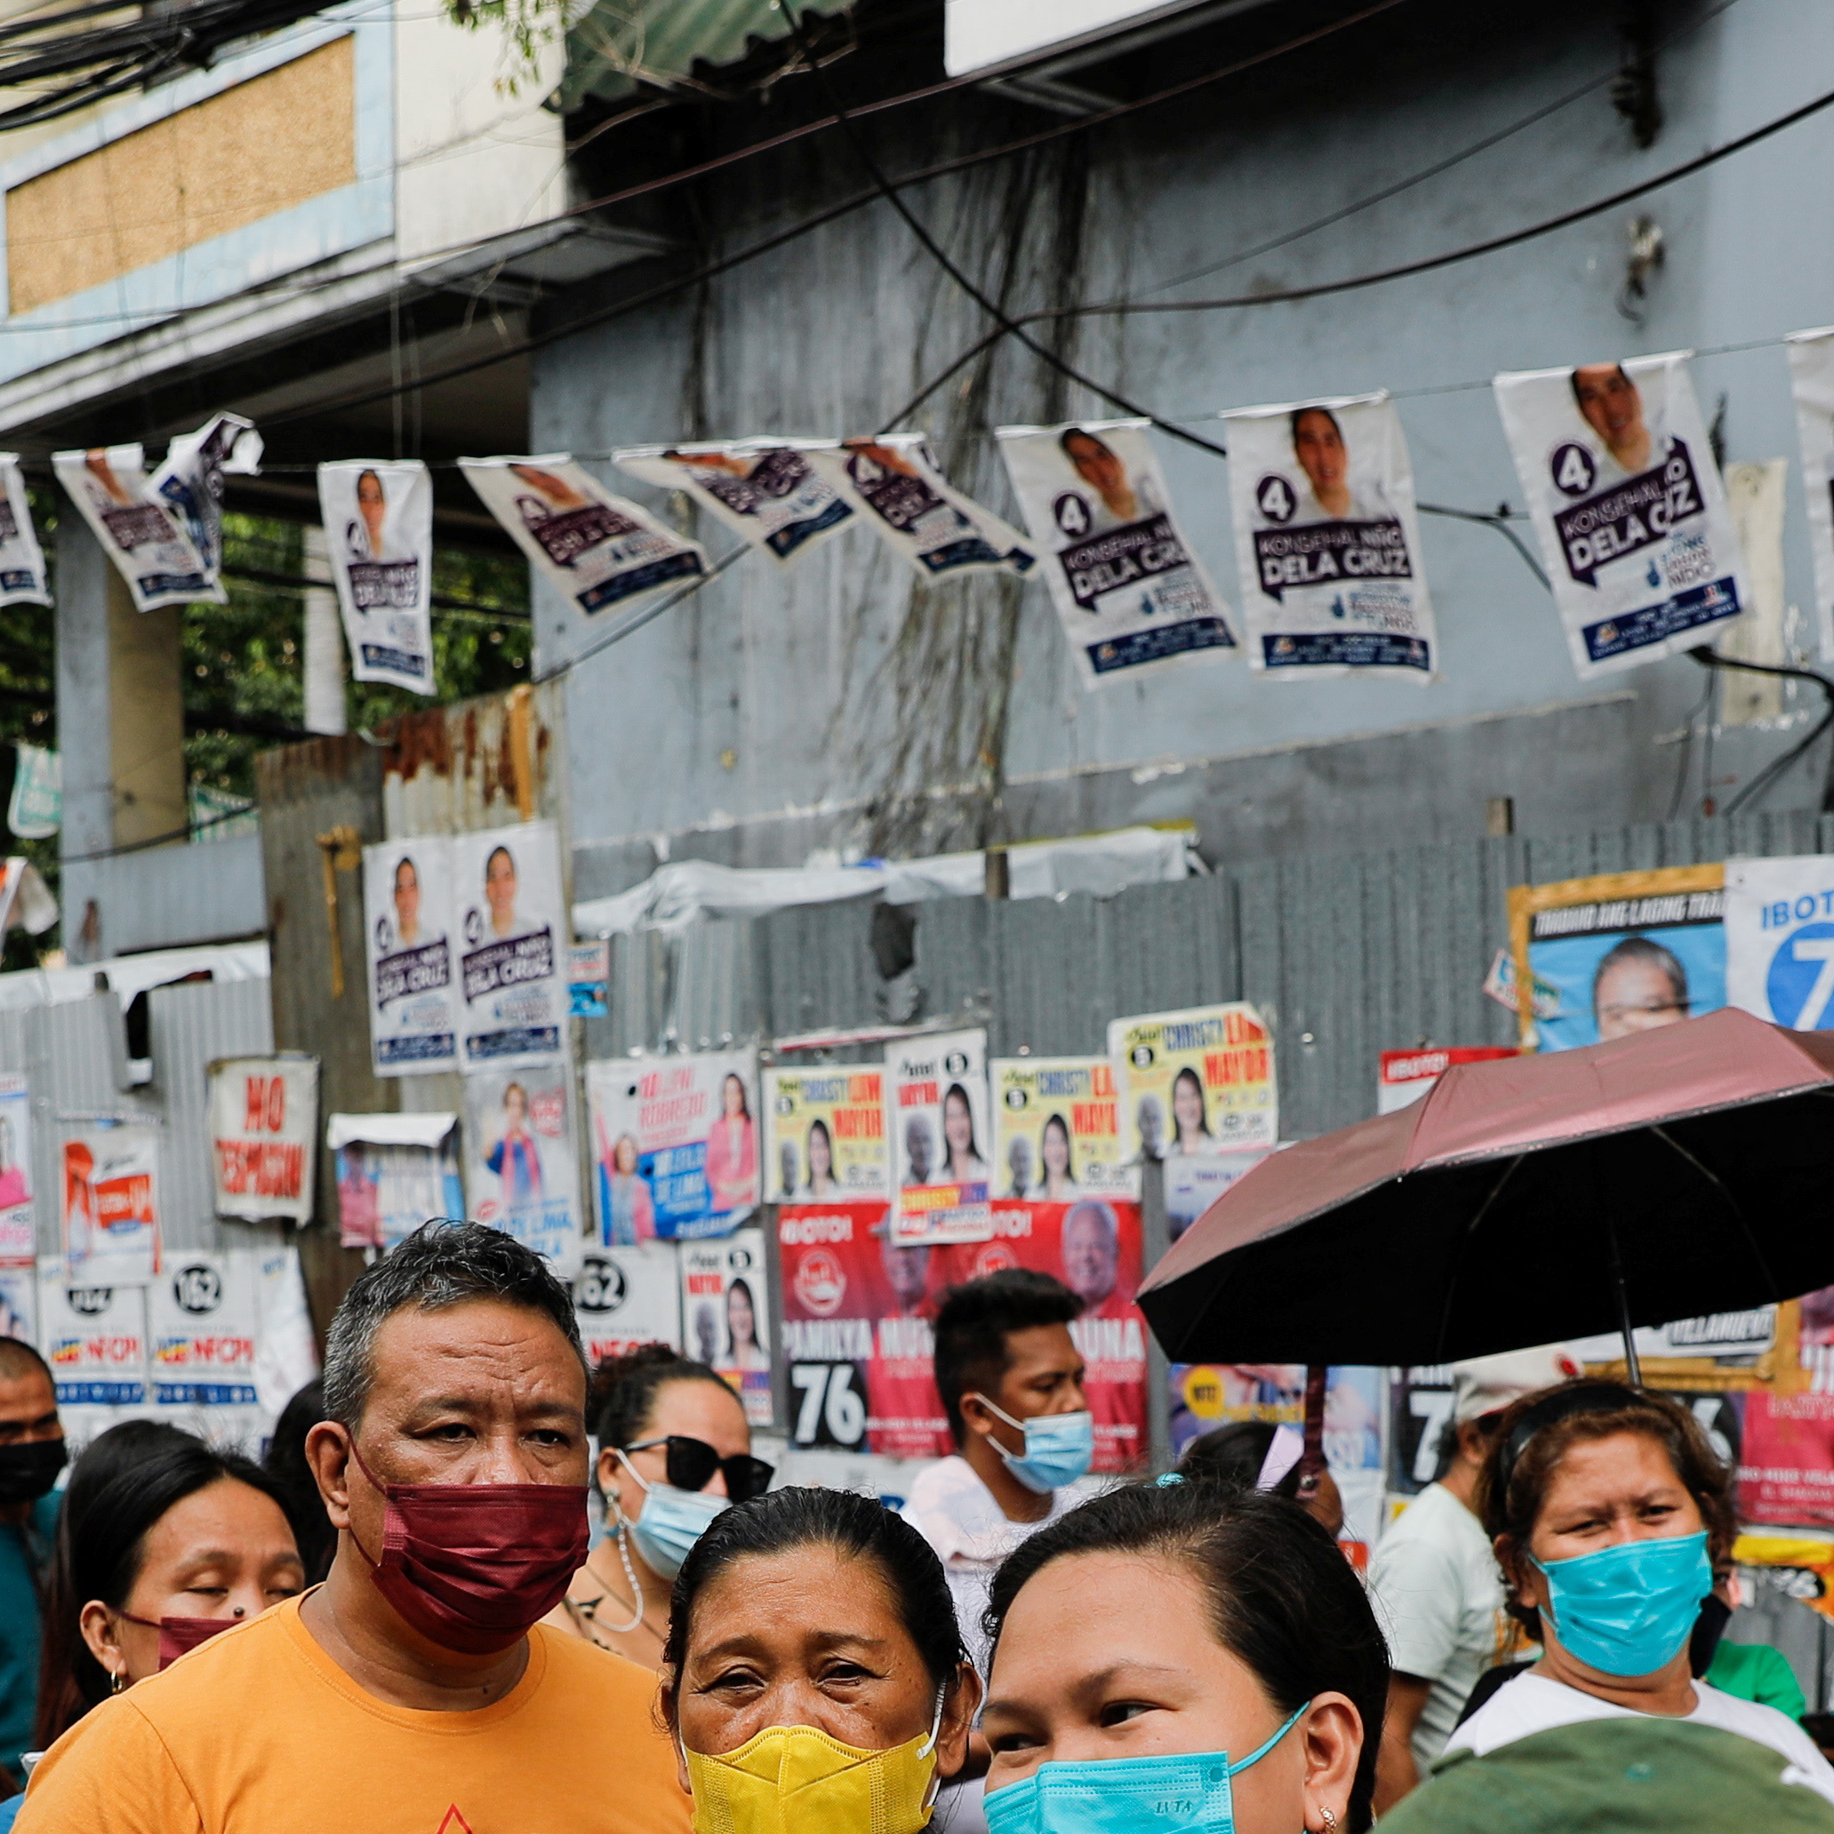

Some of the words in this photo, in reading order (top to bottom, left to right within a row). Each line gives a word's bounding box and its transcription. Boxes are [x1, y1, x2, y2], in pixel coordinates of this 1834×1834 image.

[1557, 446, 1593, 491] 4
[1060, 496, 1088, 535] 4
[1260, 478, 1291, 522] 4
[1568, 512, 1650, 572] DELA
[1071, 553, 1143, 600] DELA
[1262, 550, 1340, 586] DELA
[1342, 547, 1410, 576] CRUZ
[1203, 1047, 1269, 1088] MAYOR
[244, 1075, 285, 1132] NO
[575, 1262, 623, 1311] 62
[1066, 1317, 1146, 1363] UNA
[791, 1363, 867, 1446] 76
